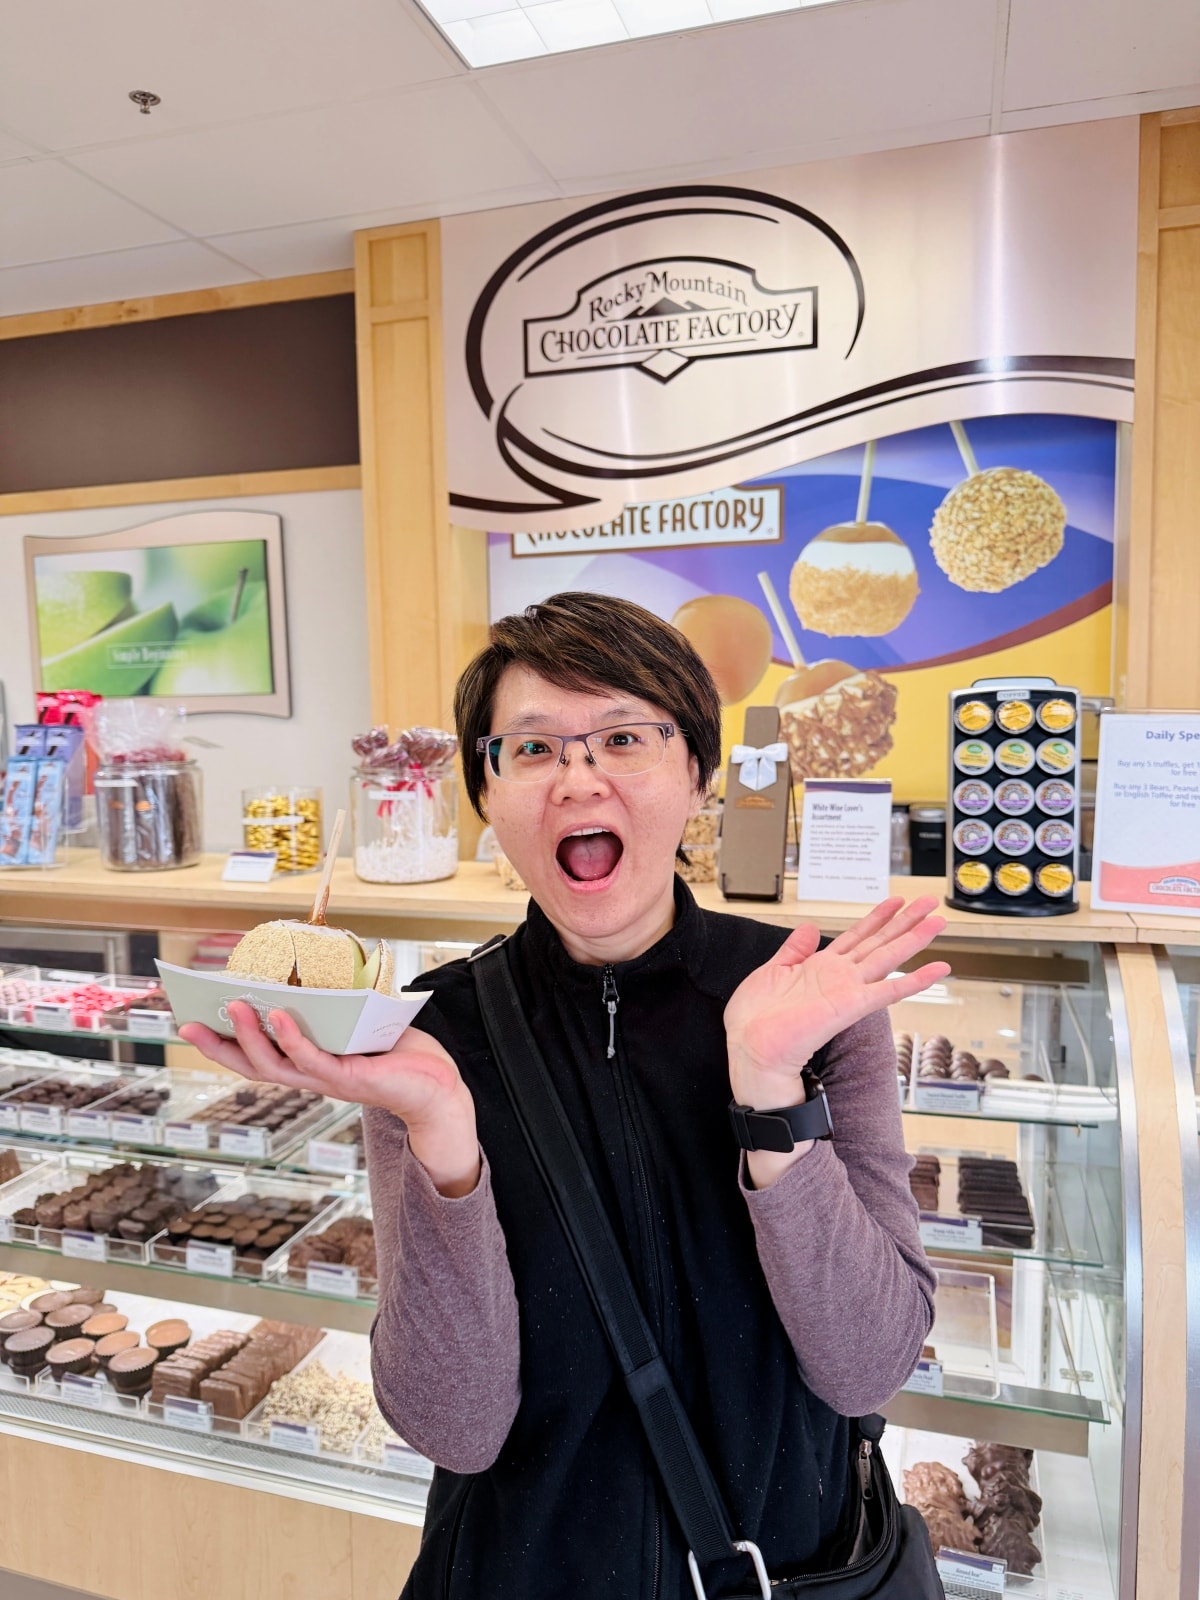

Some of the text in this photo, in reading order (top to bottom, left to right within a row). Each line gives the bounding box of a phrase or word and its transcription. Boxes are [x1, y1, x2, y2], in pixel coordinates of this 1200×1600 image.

[589, 271, 748, 325] Rocky Mountain
[540, 303, 801, 363] CHOCOLATE FACTORY
[659, 497, 764, 533] FACTORY
[1146, 730, 1175, 742] Daily
